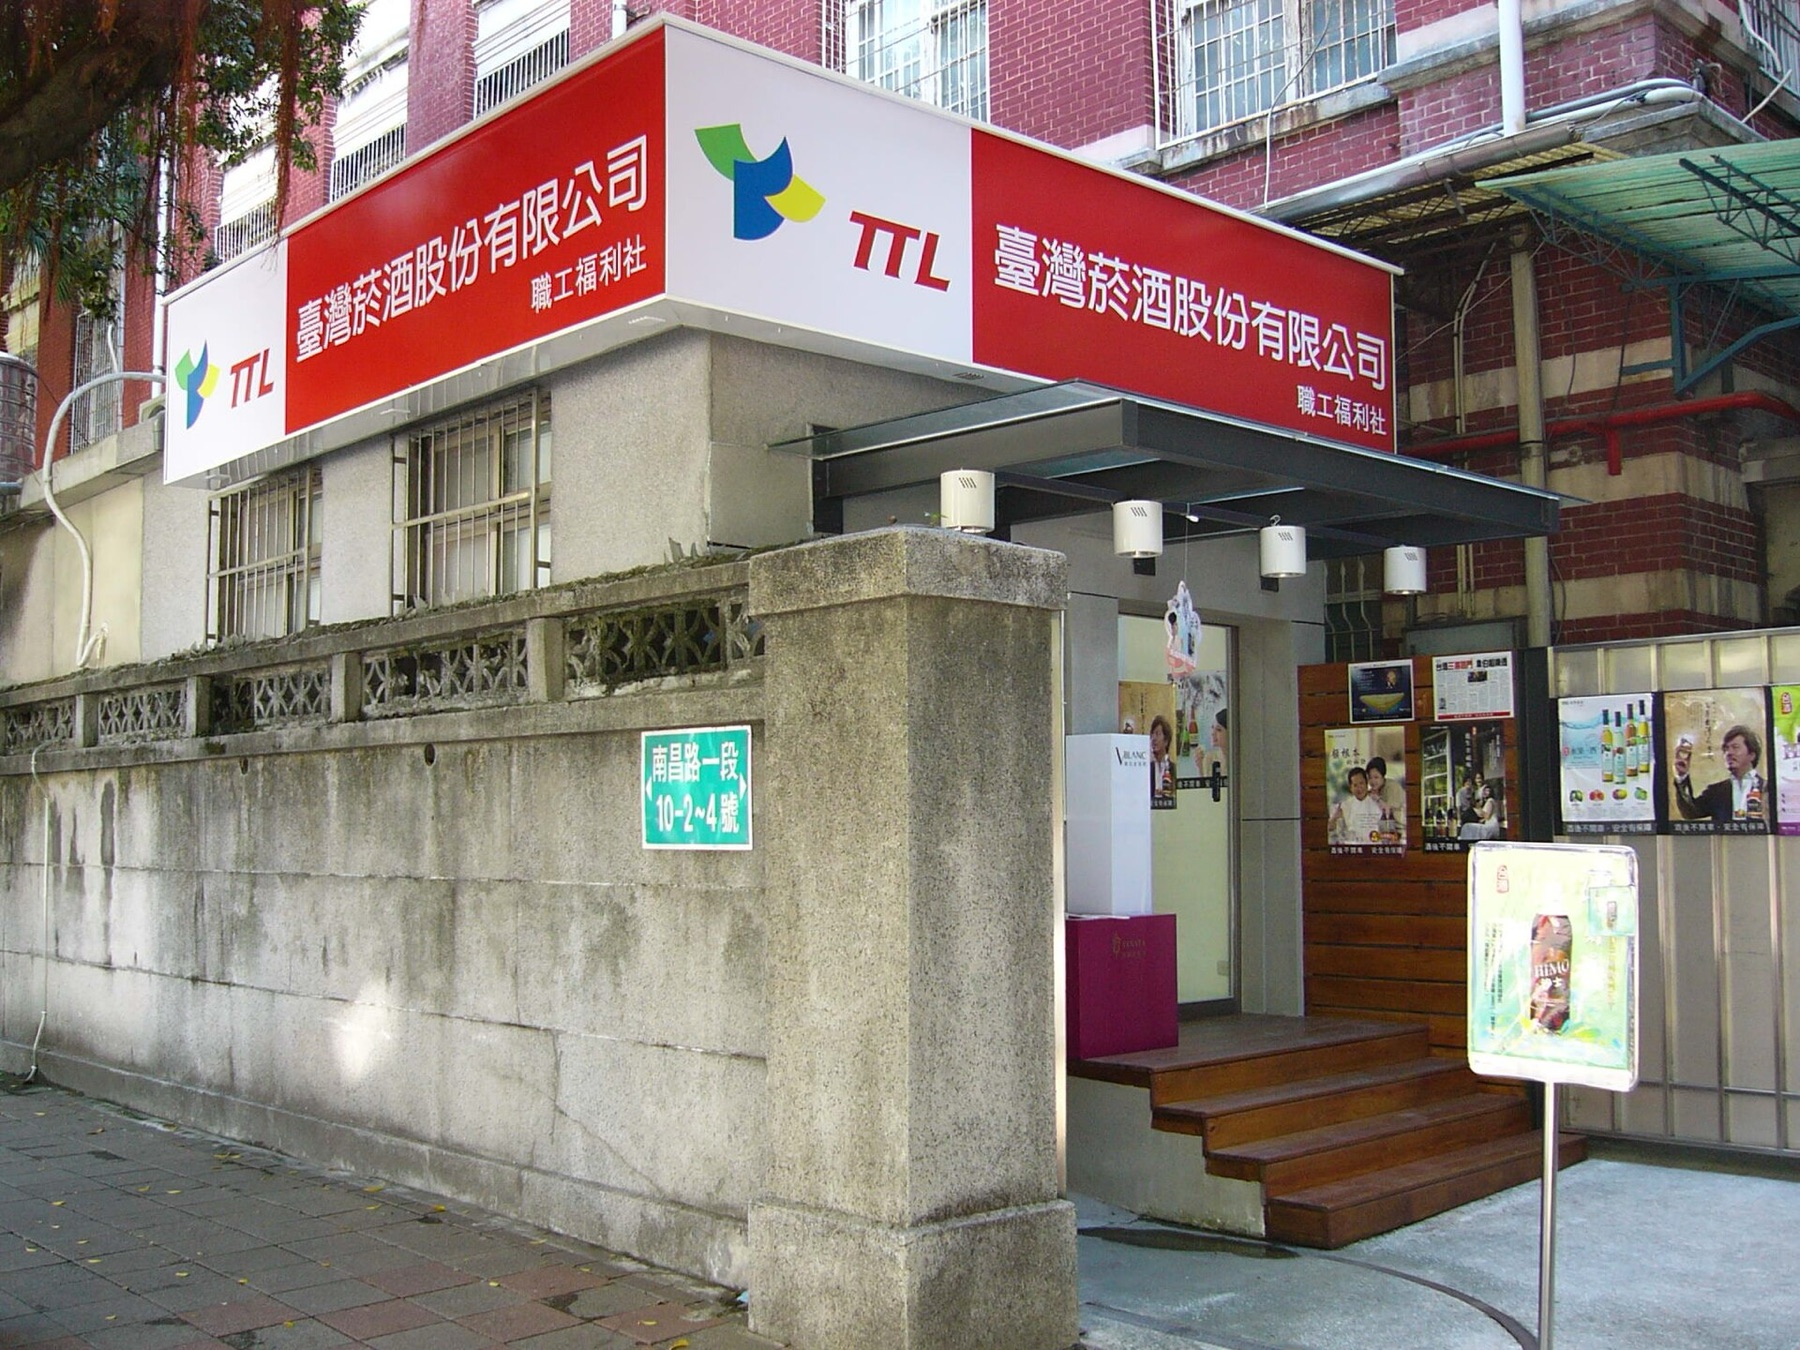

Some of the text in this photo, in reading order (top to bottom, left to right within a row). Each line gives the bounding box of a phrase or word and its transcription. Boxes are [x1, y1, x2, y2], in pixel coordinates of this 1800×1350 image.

[296, 135, 647, 362] 臺灣菸酒股份有限公司
[530, 234, 648, 314] 職工福利社
[849, 211, 950, 292] TTL
[994, 224, 1386, 390] 臺灣菸酒股份有限公司
[229, 347, 274, 409] TTL
[1297, 384, 1387, 436] 職工福利社
[652, 742, 739, 782] 南昌路一段
